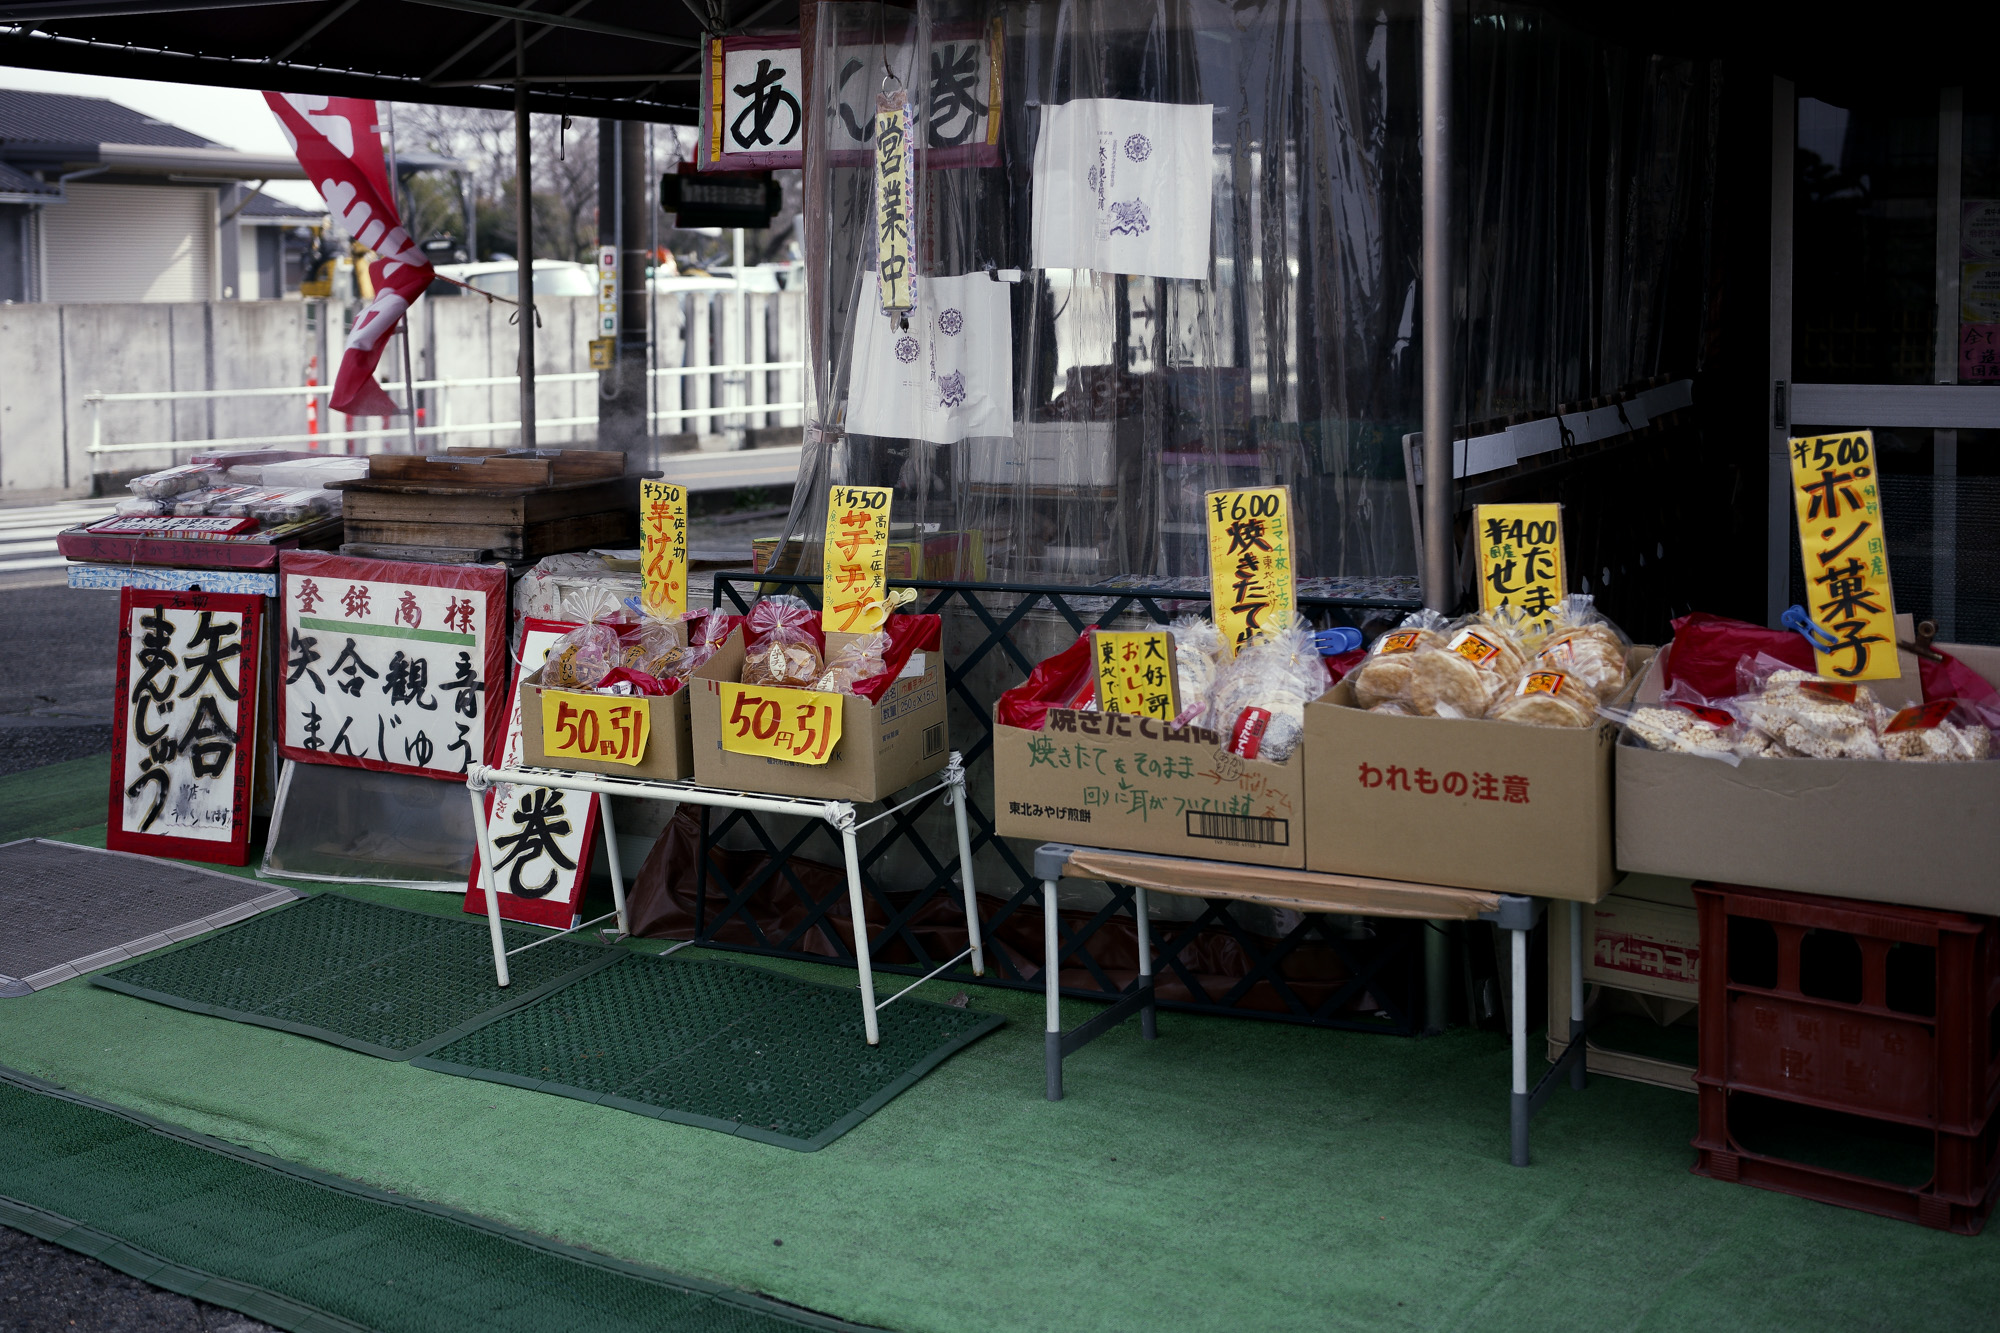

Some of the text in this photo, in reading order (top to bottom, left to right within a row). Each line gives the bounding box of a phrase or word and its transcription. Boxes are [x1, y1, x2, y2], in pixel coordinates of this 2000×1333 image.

[877, 114, 908, 307] 営業中
[1793, 436, 1869, 471] ¥500
[643, 483, 680, 502] ¥550
[834, 489, 887, 510] ¥550
[1212, 493, 1280, 522] ¥600
[647, 500, 680, 608] 芋けんぴ
[673, 506, 686, 563] 土佐名物
[1485, 518, 1557, 548] ¥400
[1801, 465, 1891, 678] ポン菓子
[294, 578, 477, 635] 登録商標
[178, 611, 243, 779] 矢合
[286, 626, 485, 720] 矢合観音
[1142, 636, 1170, 721] 大好評
[126, 604, 179, 833] まんじゅう
[300, 702, 479, 775] まんじゅう
[556, 701, 643, 759] 50円引
[730, 692, 832, 759] 50円引
[1009, 801, 1092, 823] 東北みやげ煎餅
[1358, 761, 1531, 804] われもの注意
[494, 788, 578, 898] 巻
